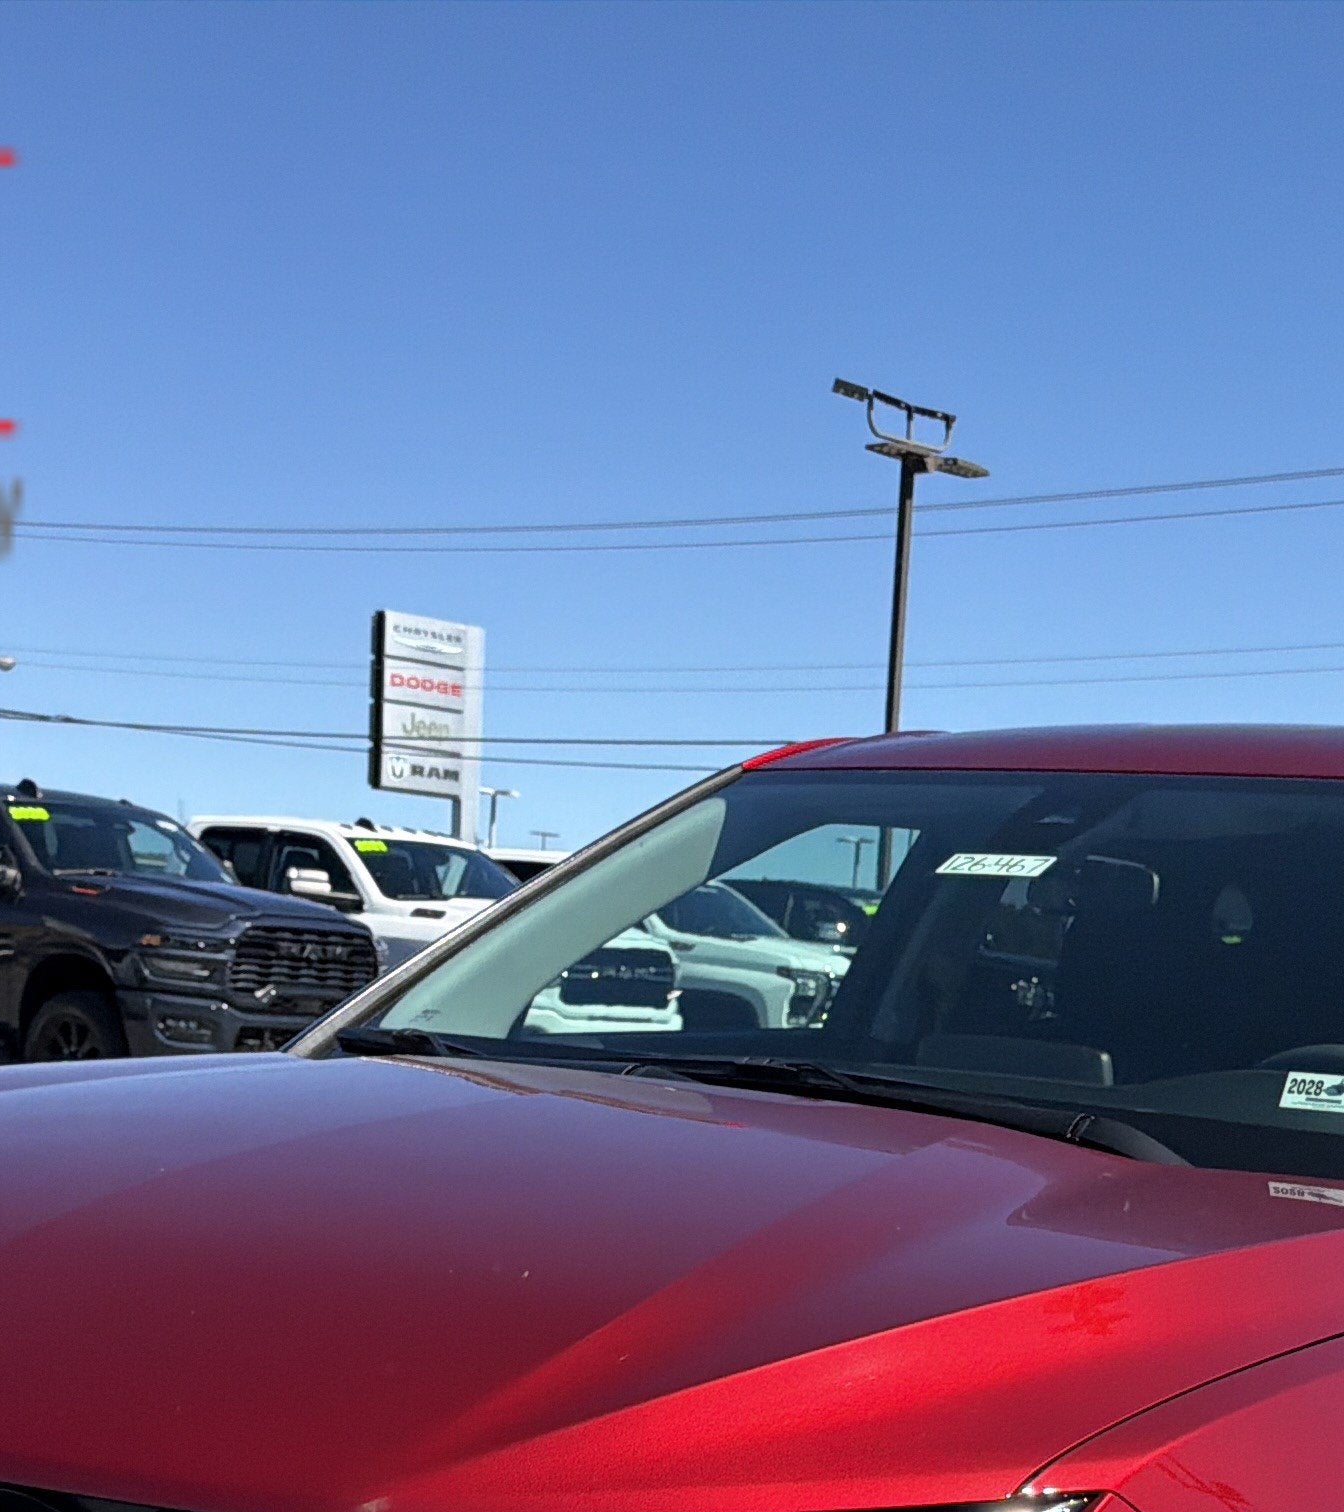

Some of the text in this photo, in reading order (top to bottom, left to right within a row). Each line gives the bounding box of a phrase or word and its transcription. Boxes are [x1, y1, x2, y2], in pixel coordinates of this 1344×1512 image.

[392, 624, 462, 643] CHRYSLER
[390, 672, 462, 697] DODGE
[409, 763, 460, 782] RAM
[1287, 1078, 1325, 1097] 2028
